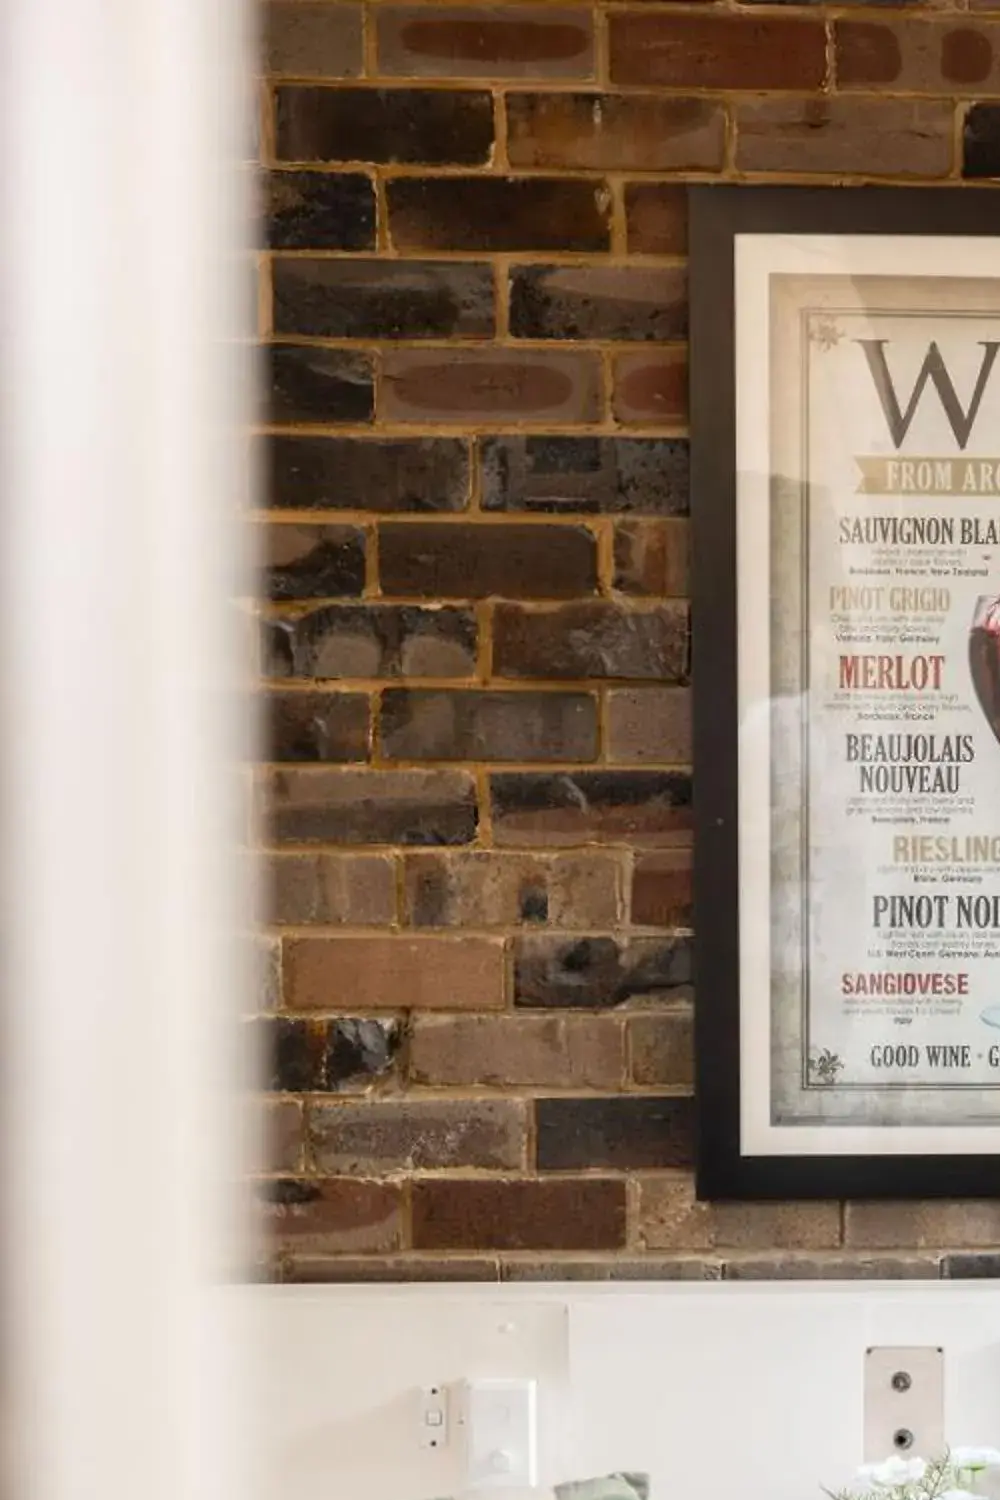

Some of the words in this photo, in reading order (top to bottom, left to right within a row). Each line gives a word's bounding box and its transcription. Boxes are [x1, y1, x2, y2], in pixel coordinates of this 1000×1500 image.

[886, 461, 952, 490] FROM
[839, 517, 953, 545] SAUVIGNON
[829, 586, 884, 612] PINOT
[889, 587, 951, 612] GRIGIO
[839, 655, 945, 690] MERLOT
[846, 734, 975, 763] BEAUJOLAIS
[860, 766, 961, 794] NOUVEAU
[873, 895, 949, 928] PINOT
[841, 972, 969, 995] SANGIOVESE
[870, 1045, 919, 1067] GOOD
[926, 1045, 971, 1067] WINE
